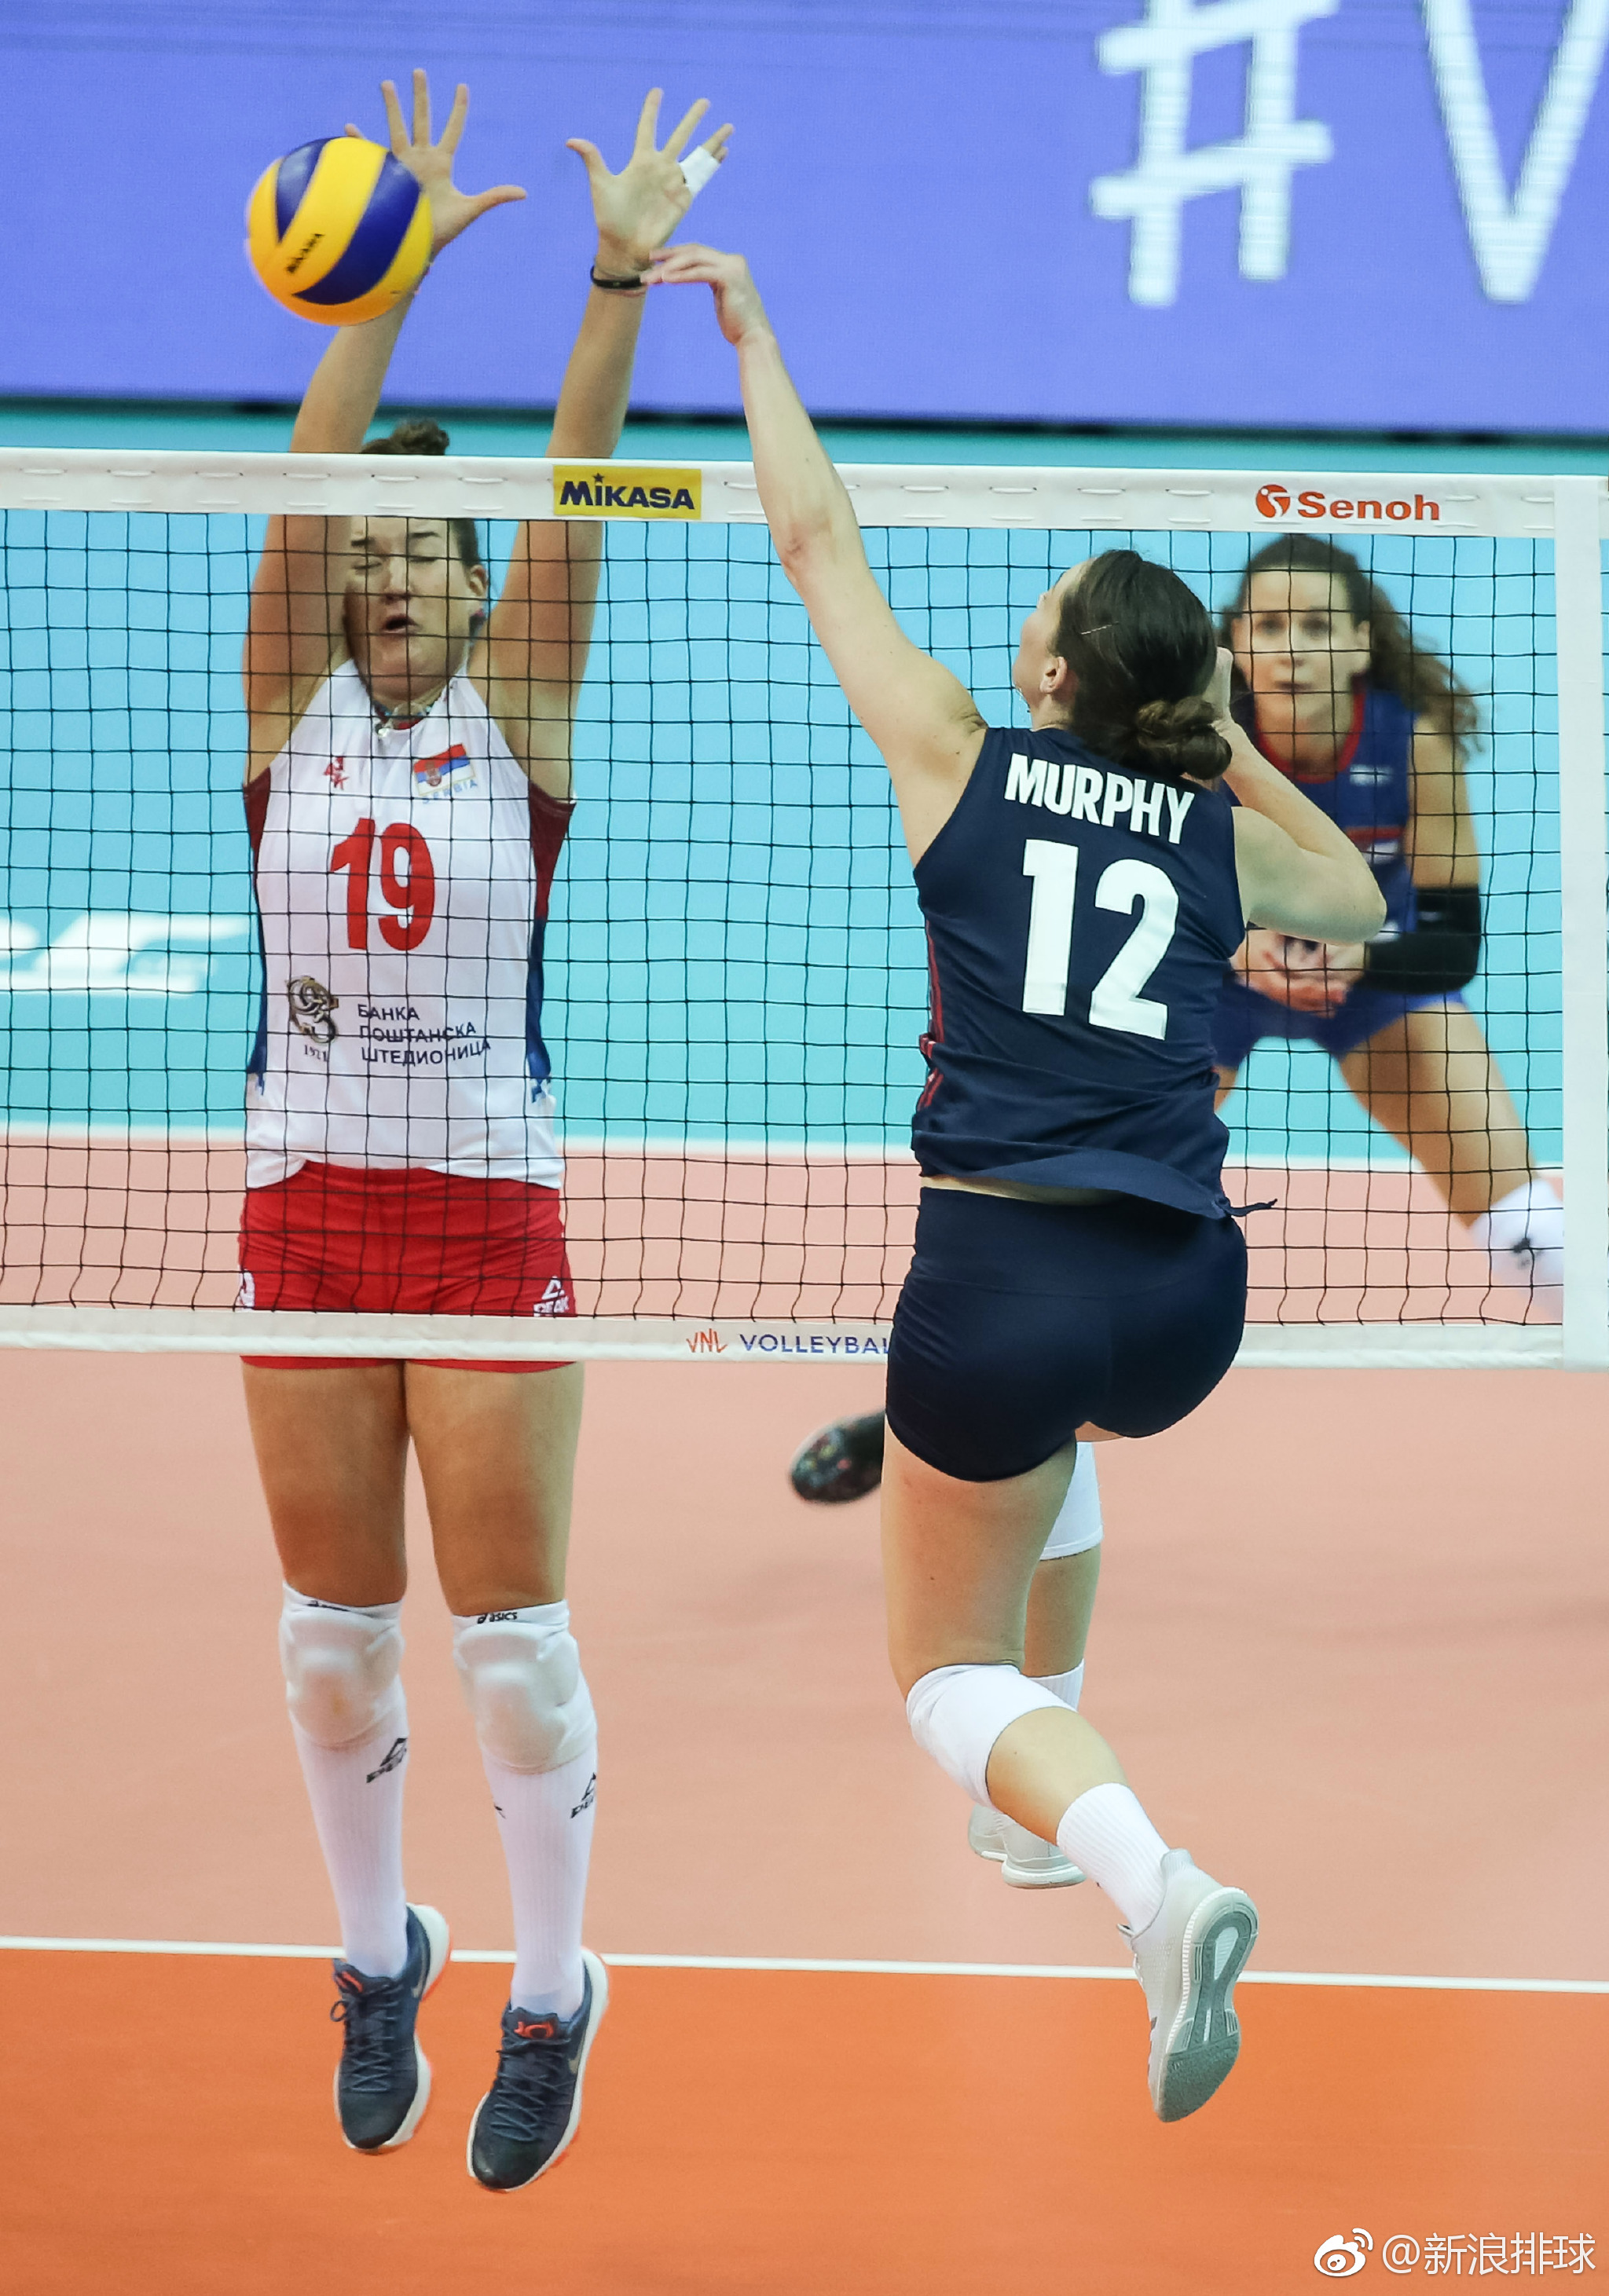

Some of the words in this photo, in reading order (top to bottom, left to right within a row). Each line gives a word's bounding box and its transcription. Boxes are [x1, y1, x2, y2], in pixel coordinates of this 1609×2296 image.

[1298, 491, 1439, 520] Senoh
[1004, 753, 1194, 844] MURPHY
[330, 816, 435, 950] 19
[1022, 839, 1178, 1040] 12
[357, 1003, 420, 1021] БАНКА
[360, 1021, 476, 1043] ПОШТАНСКА
